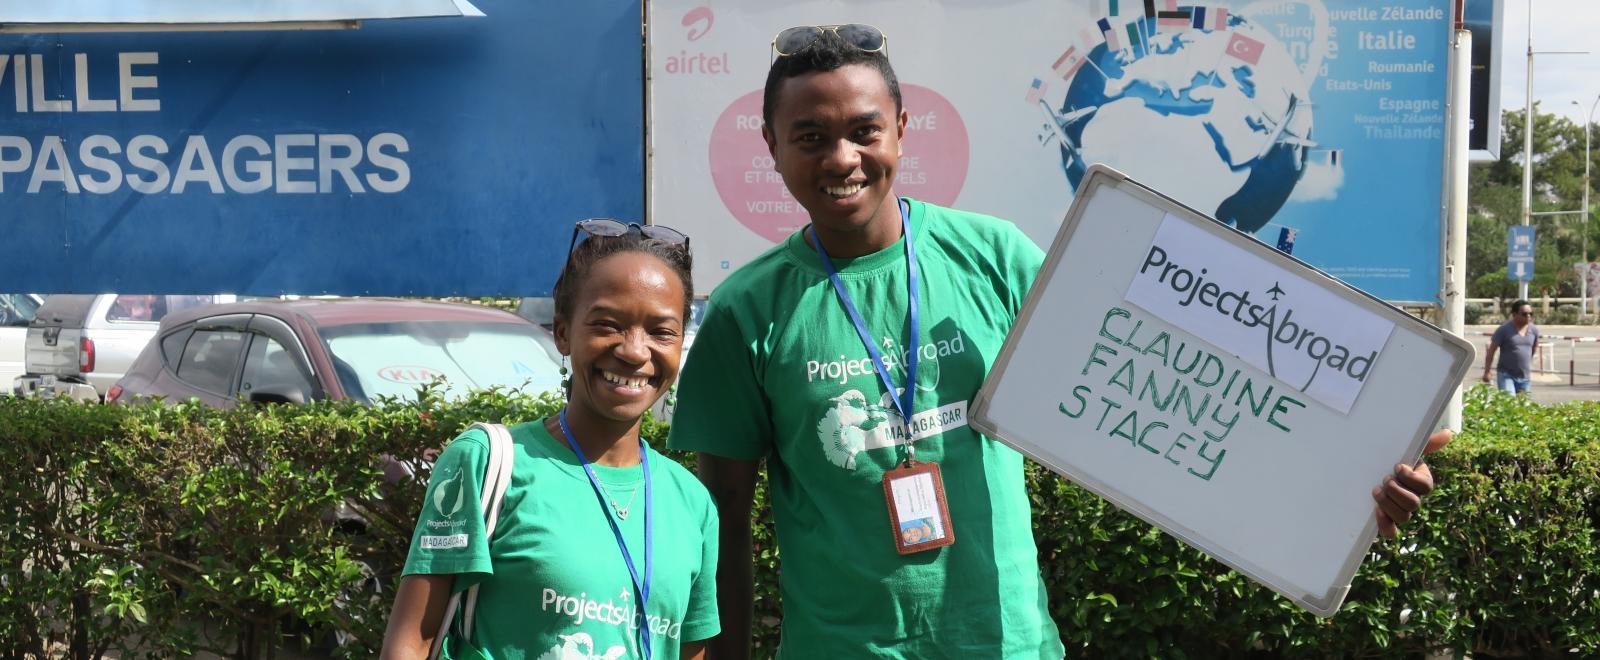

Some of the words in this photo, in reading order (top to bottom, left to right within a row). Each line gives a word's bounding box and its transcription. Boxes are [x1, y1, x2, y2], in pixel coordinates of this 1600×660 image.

[1310, 8, 1377, 21] uvelle
[1381, 6, 1443, 20] Zélande
[1276, 23, 1336, 41] Turqe
[1358, 30, 1416, 49] Italie
[665, 51, 731, 75] airtel
[1368, 60, 1435, 73] Roumanie
[1325, 79, 1392, 91] Etats-Unis
[1379, 97, 1440, 112] Espagne
[0, 132, 411, 195] PASSAGERS
[745, 170, 763, 184] ET
[746, 201, 792, 214] VOTRE
[1099, 306, 1306, 433] CLAUDINE
[1081, 343, 1240, 443] FANNY
[885, 407, 962, 441] MAAGASCAR
[1058, 385, 1227, 481] STACEY
